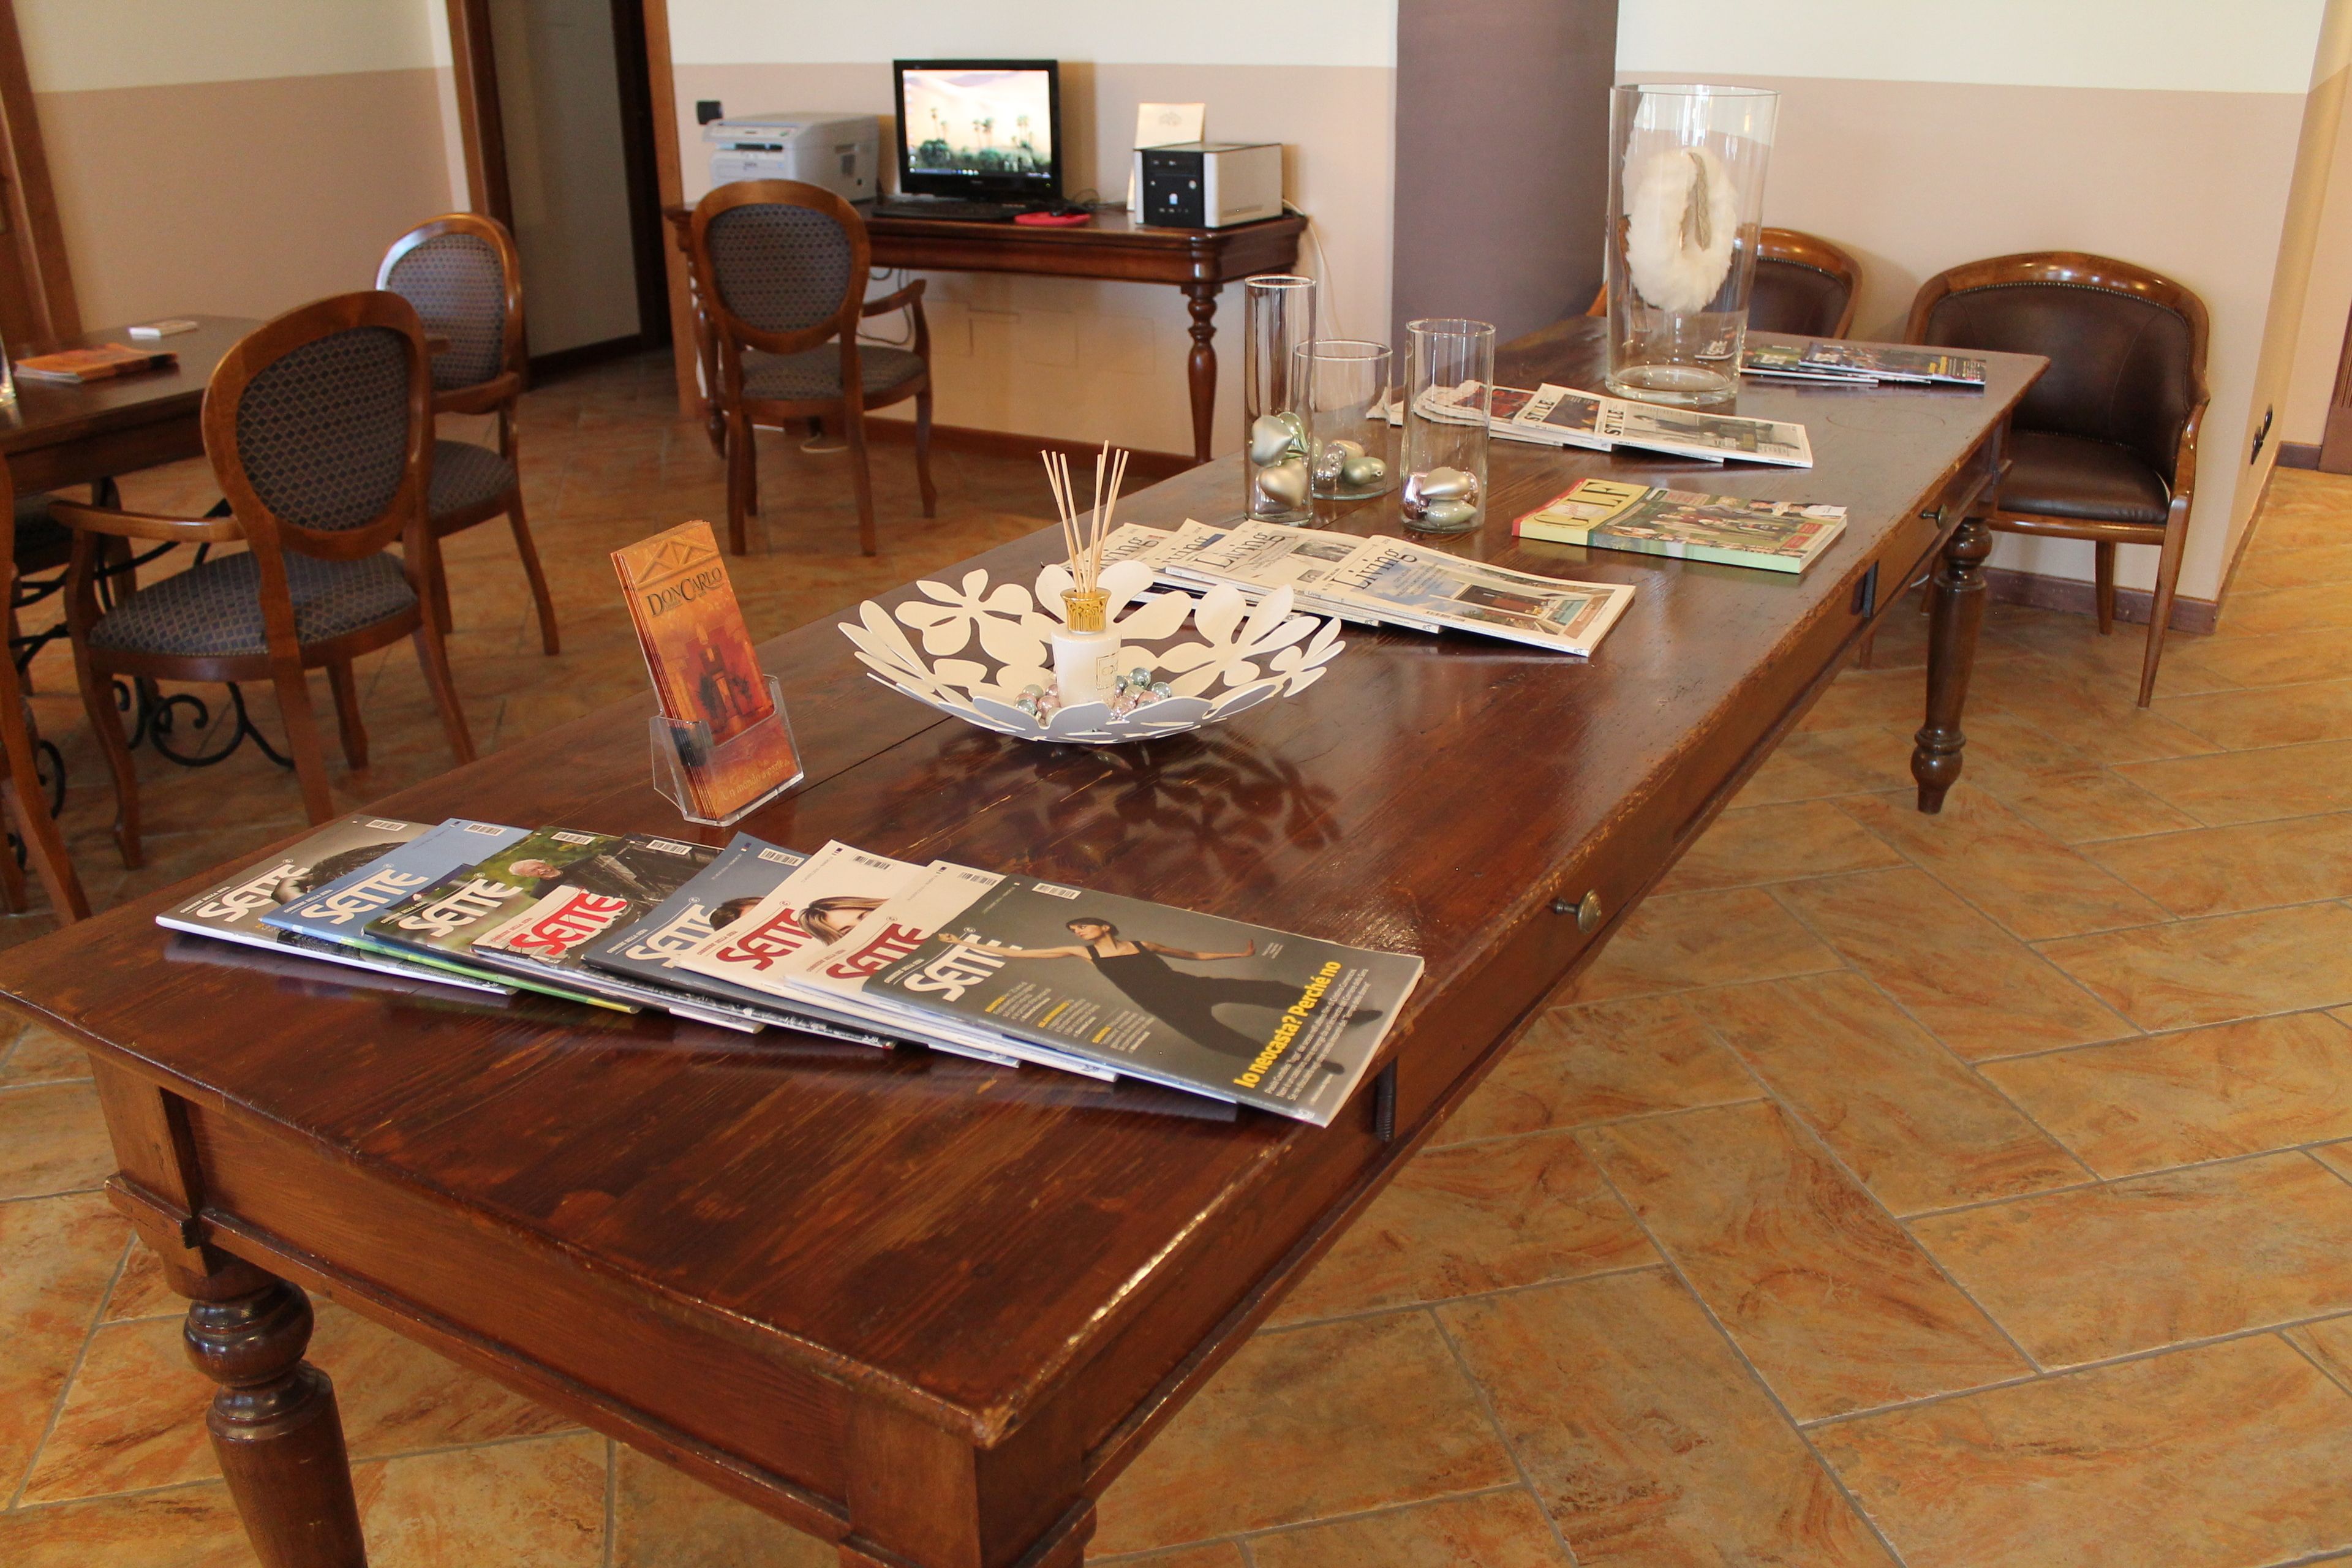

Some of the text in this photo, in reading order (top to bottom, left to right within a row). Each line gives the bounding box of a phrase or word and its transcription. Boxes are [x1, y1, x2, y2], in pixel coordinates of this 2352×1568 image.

[1193, 532, 1286, 568] Living
[1331, 548, 1417, 590] Living
[1308, 590, 1321, 599] Living
[301, 869, 429, 925] SETTE
[398, 878, 524, 938] SETTE
[510, 892, 628, 956] SETTE
[715, 908, 813, 971] SETT
[826, 923, 932, 979] SETTE
[1248, 1016, 1303, 1075] neocasta?
[1288, 976, 1330, 1017] Perché
[1320, 960, 1342, 979] no
